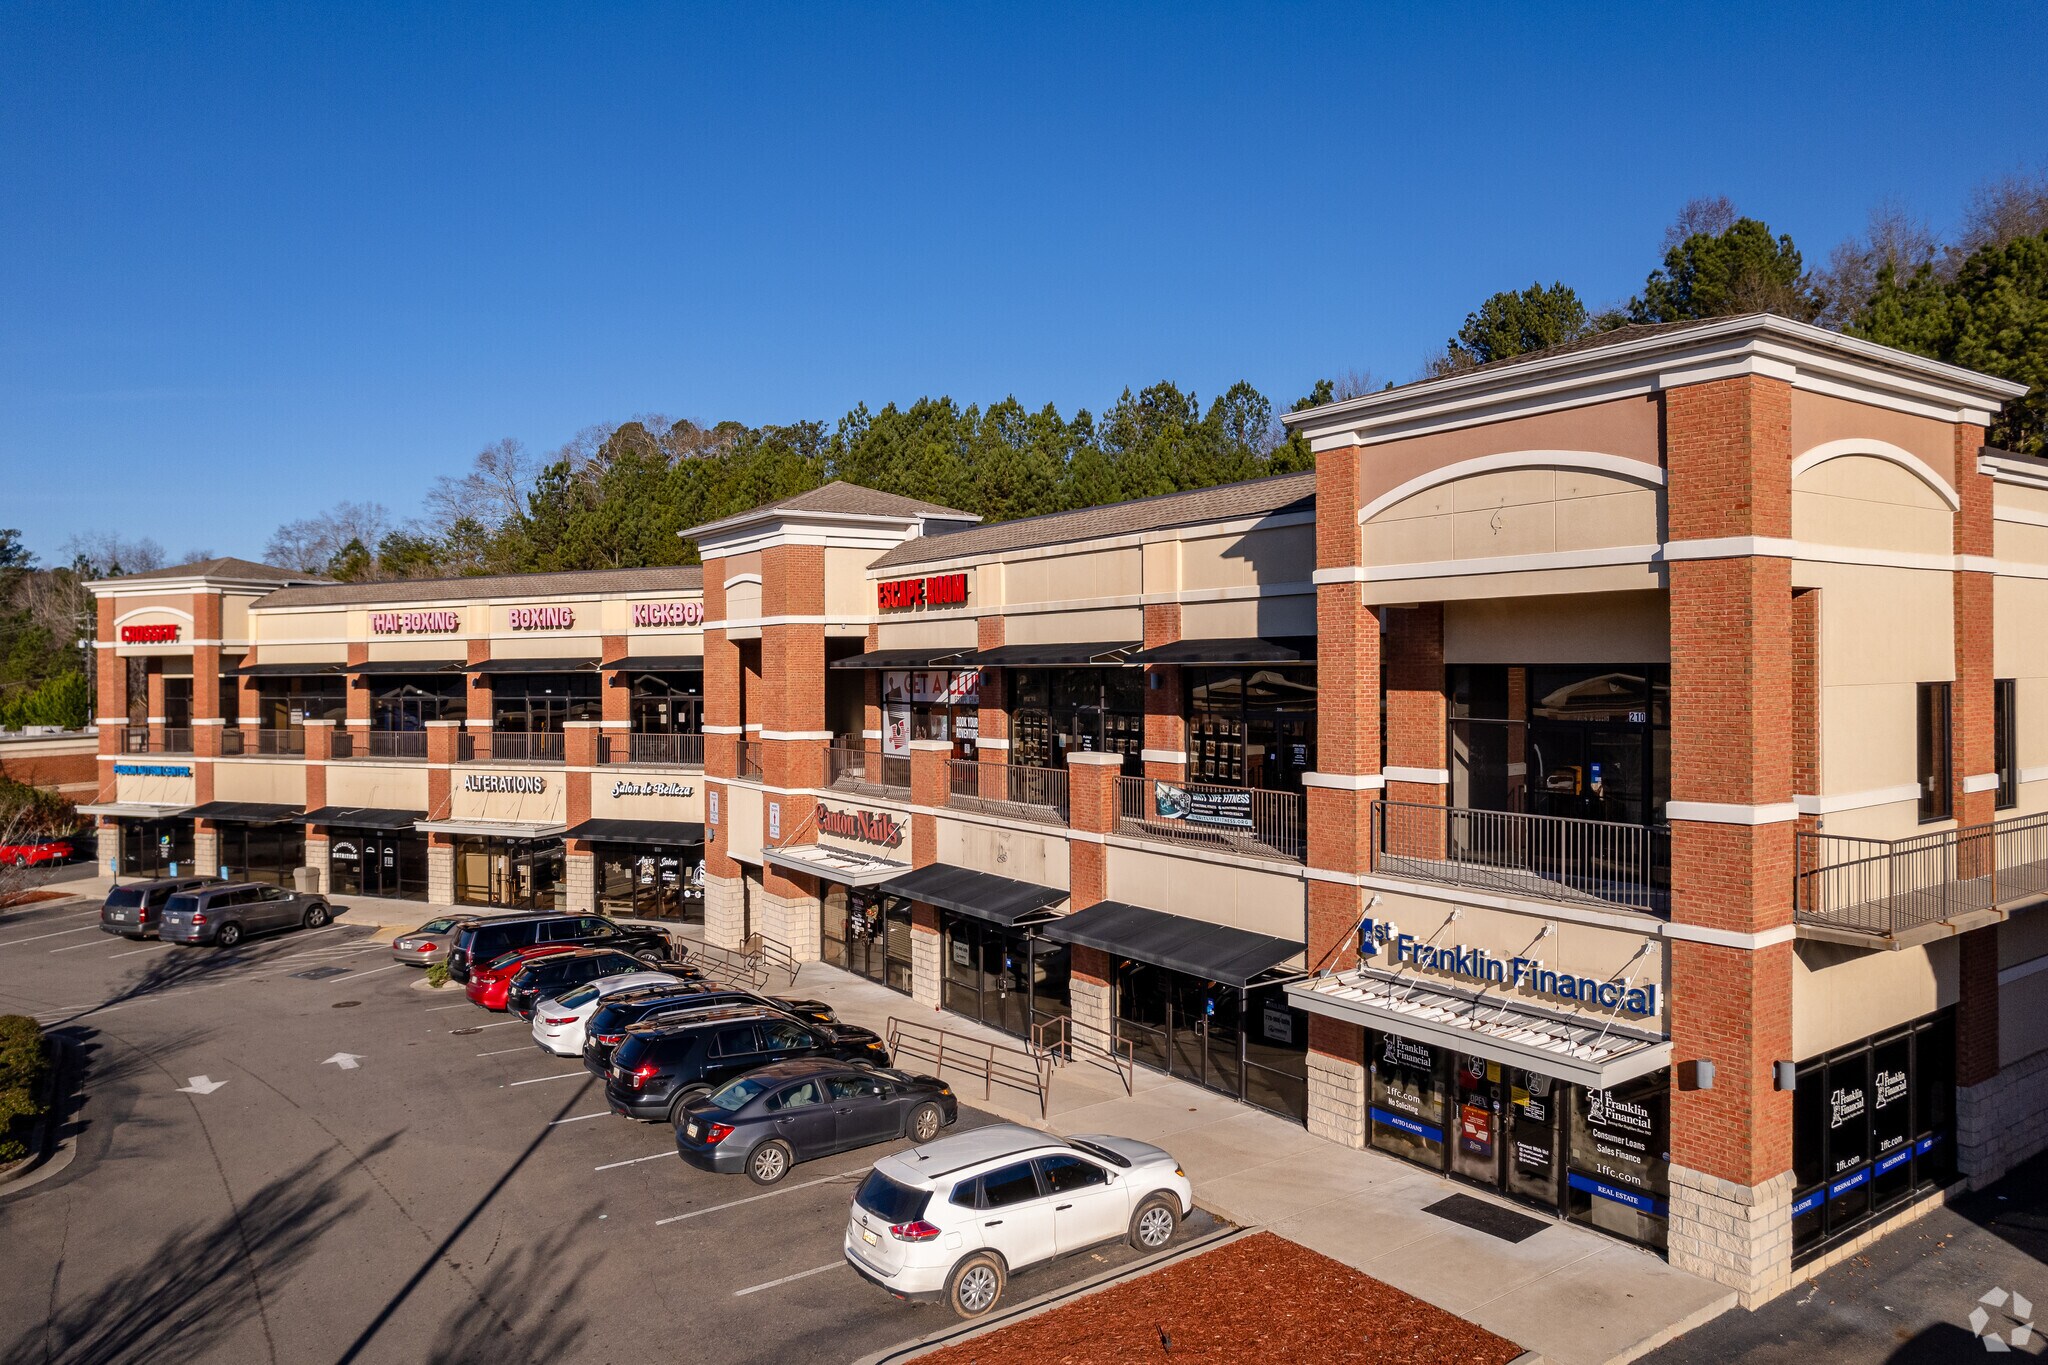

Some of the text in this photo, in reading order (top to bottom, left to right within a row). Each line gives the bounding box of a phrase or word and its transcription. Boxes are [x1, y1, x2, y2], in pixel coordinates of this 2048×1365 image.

[878, 573, 965, 608] ESCAPE ROOM
[369, 612, 458, 631] THAI BOXING
[509, 607, 573, 628] BOXING
[122, 624, 178, 642] CROSSFIT
[904, 673, 928, 694] GET
[932, 674, 943, 694] A
[956, 716, 967, 727] BOOK
[1629, 711, 1646, 723] 210
[464, 774, 544, 793] ALTERATIONS
[611, 781, 692, 797] Salon de Belleza
[1207, 793, 1222, 803] LIFE
[1222, 793, 1250, 804] FITNESS
[815, 803, 898, 844] Canton Nails
[1397, 933, 1504, 983] Franklin
[1513, 957, 1656, 1017] Financial
[1396, 1040, 1429, 1057] Franklin
[1396, 1049, 1431, 1067] Financial
[1885, 1071, 1906, 1087] Franklin
[1885, 1079, 1907, 1097] Financial
[1386, 1085, 1420, 1104] 1ffc.com
[1388, 1097, 1396, 1106] No
[1840, 1088, 1863, 1105] Franklin
[1605, 1097, 1648, 1118] Franklin
[1840, 1097, 1865, 1116] Financial
[1391, 1117, 1423, 1133] AUTO LOANS
[1605, 1107, 1652, 1129] Financial
[1517, 1141, 1533, 1151] Connect
[1592, 1128, 1646, 1151] Consumer Loans
[1880, 1135, 1903, 1151] 1ffc.com
[1597, 1144, 1641, 1164] Sales Finance
[1836, 1155, 1860, 1172] 1ffc.com
[1596, 1163, 1641, 1186] 1ffc.com
[1833, 1178, 1851, 1193] PERSONAL
[1597, 1186, 1639, 1204] REAL ESTATE
